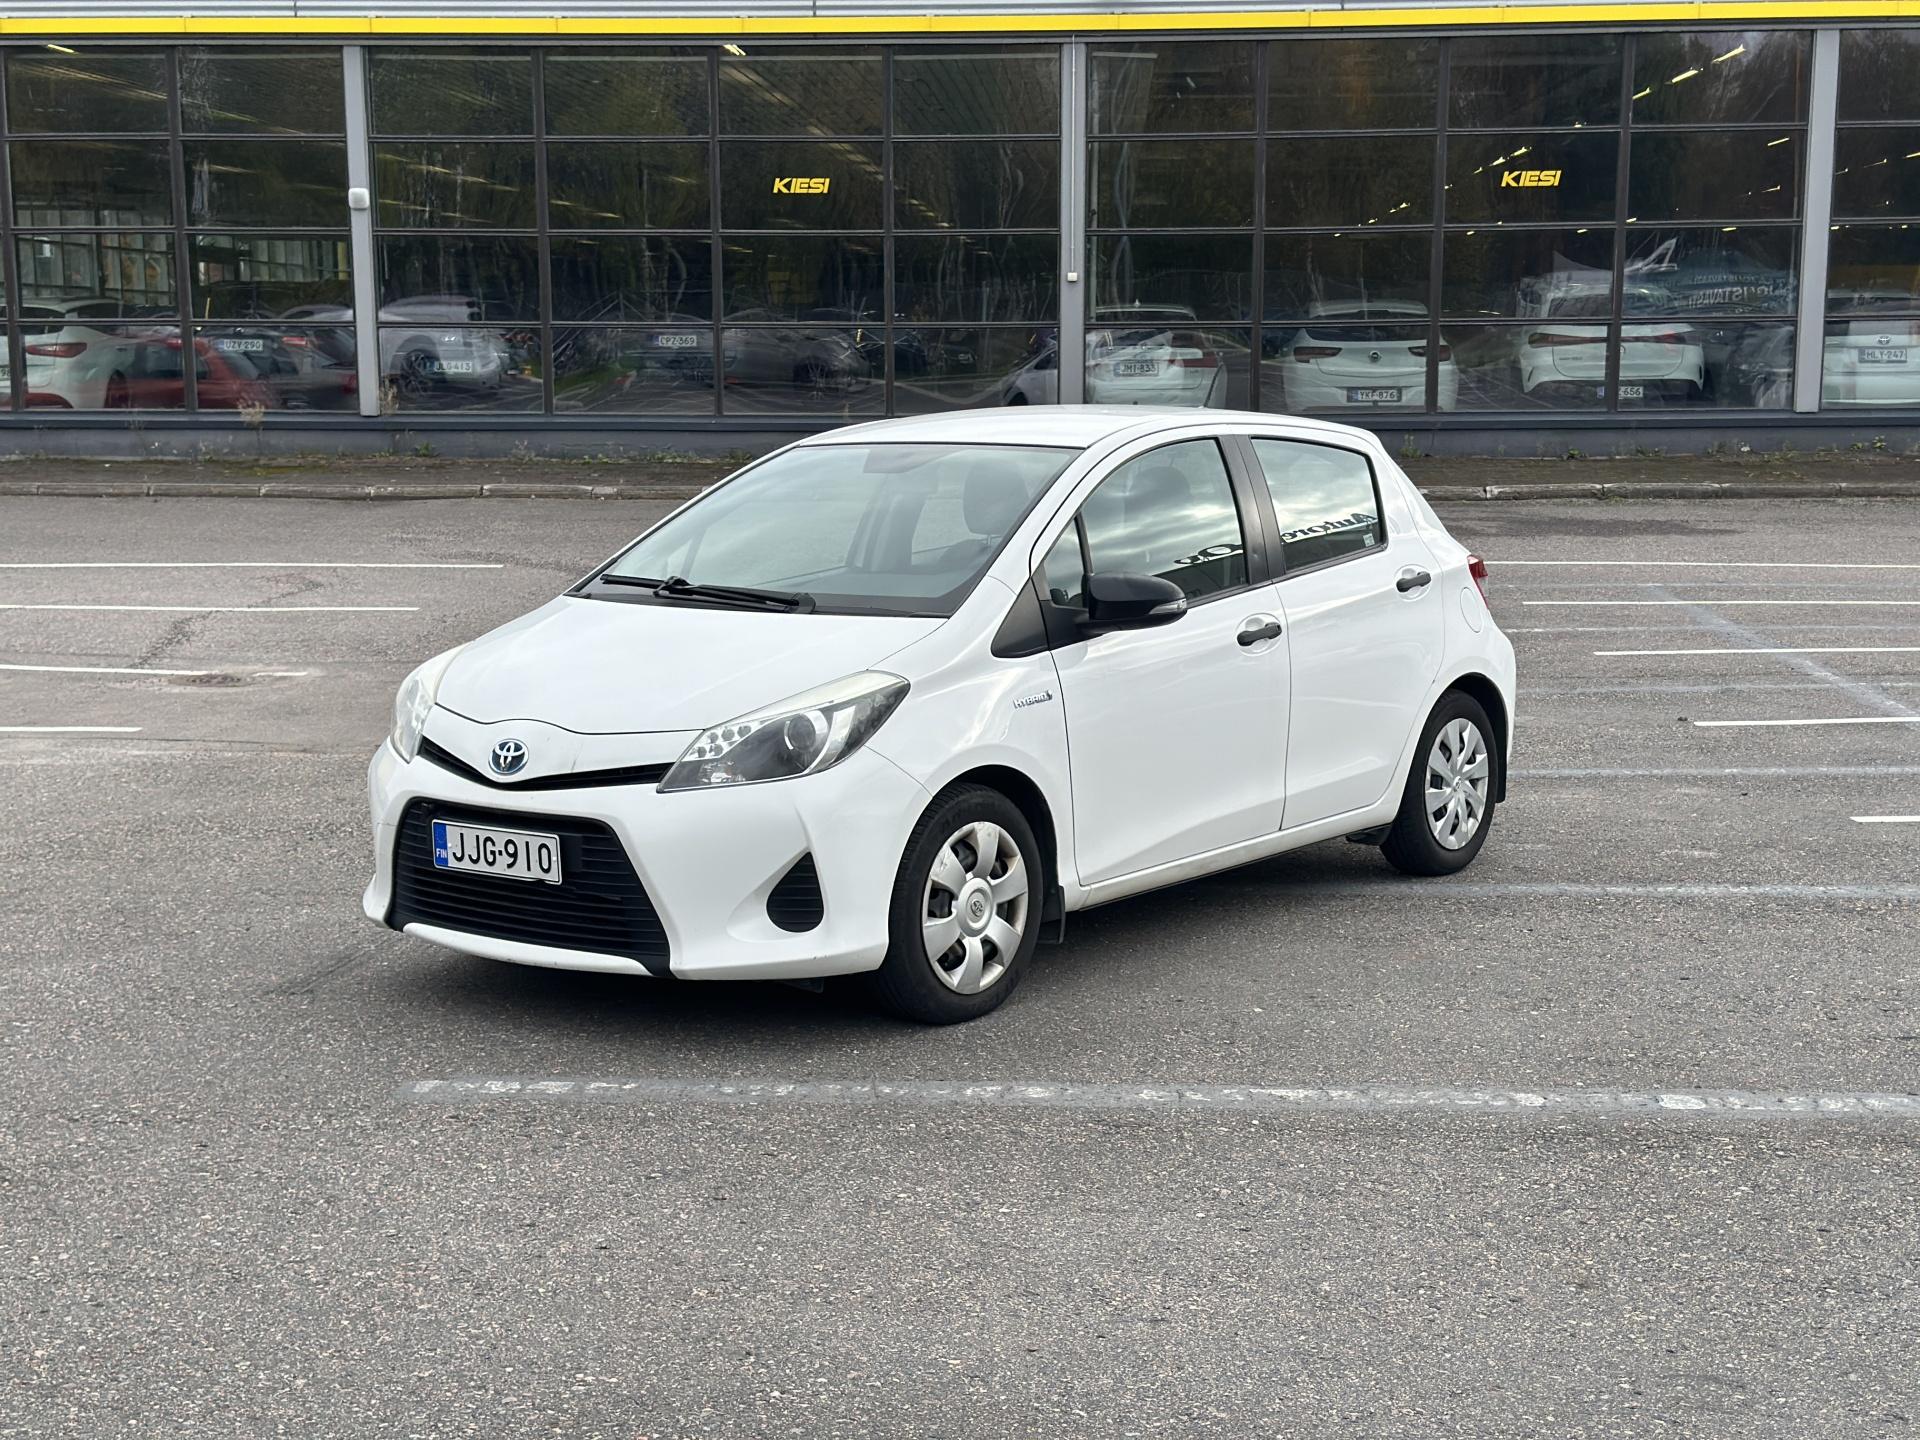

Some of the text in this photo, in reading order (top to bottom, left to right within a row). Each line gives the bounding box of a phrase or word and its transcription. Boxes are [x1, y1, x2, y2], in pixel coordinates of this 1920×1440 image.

[773, 177, 830, 193] KIESI
[1501, 170, 1562, 187] KIESI
[435, 848, 448, 859] FIN
[452, 832, 552, 874] JJG-910
